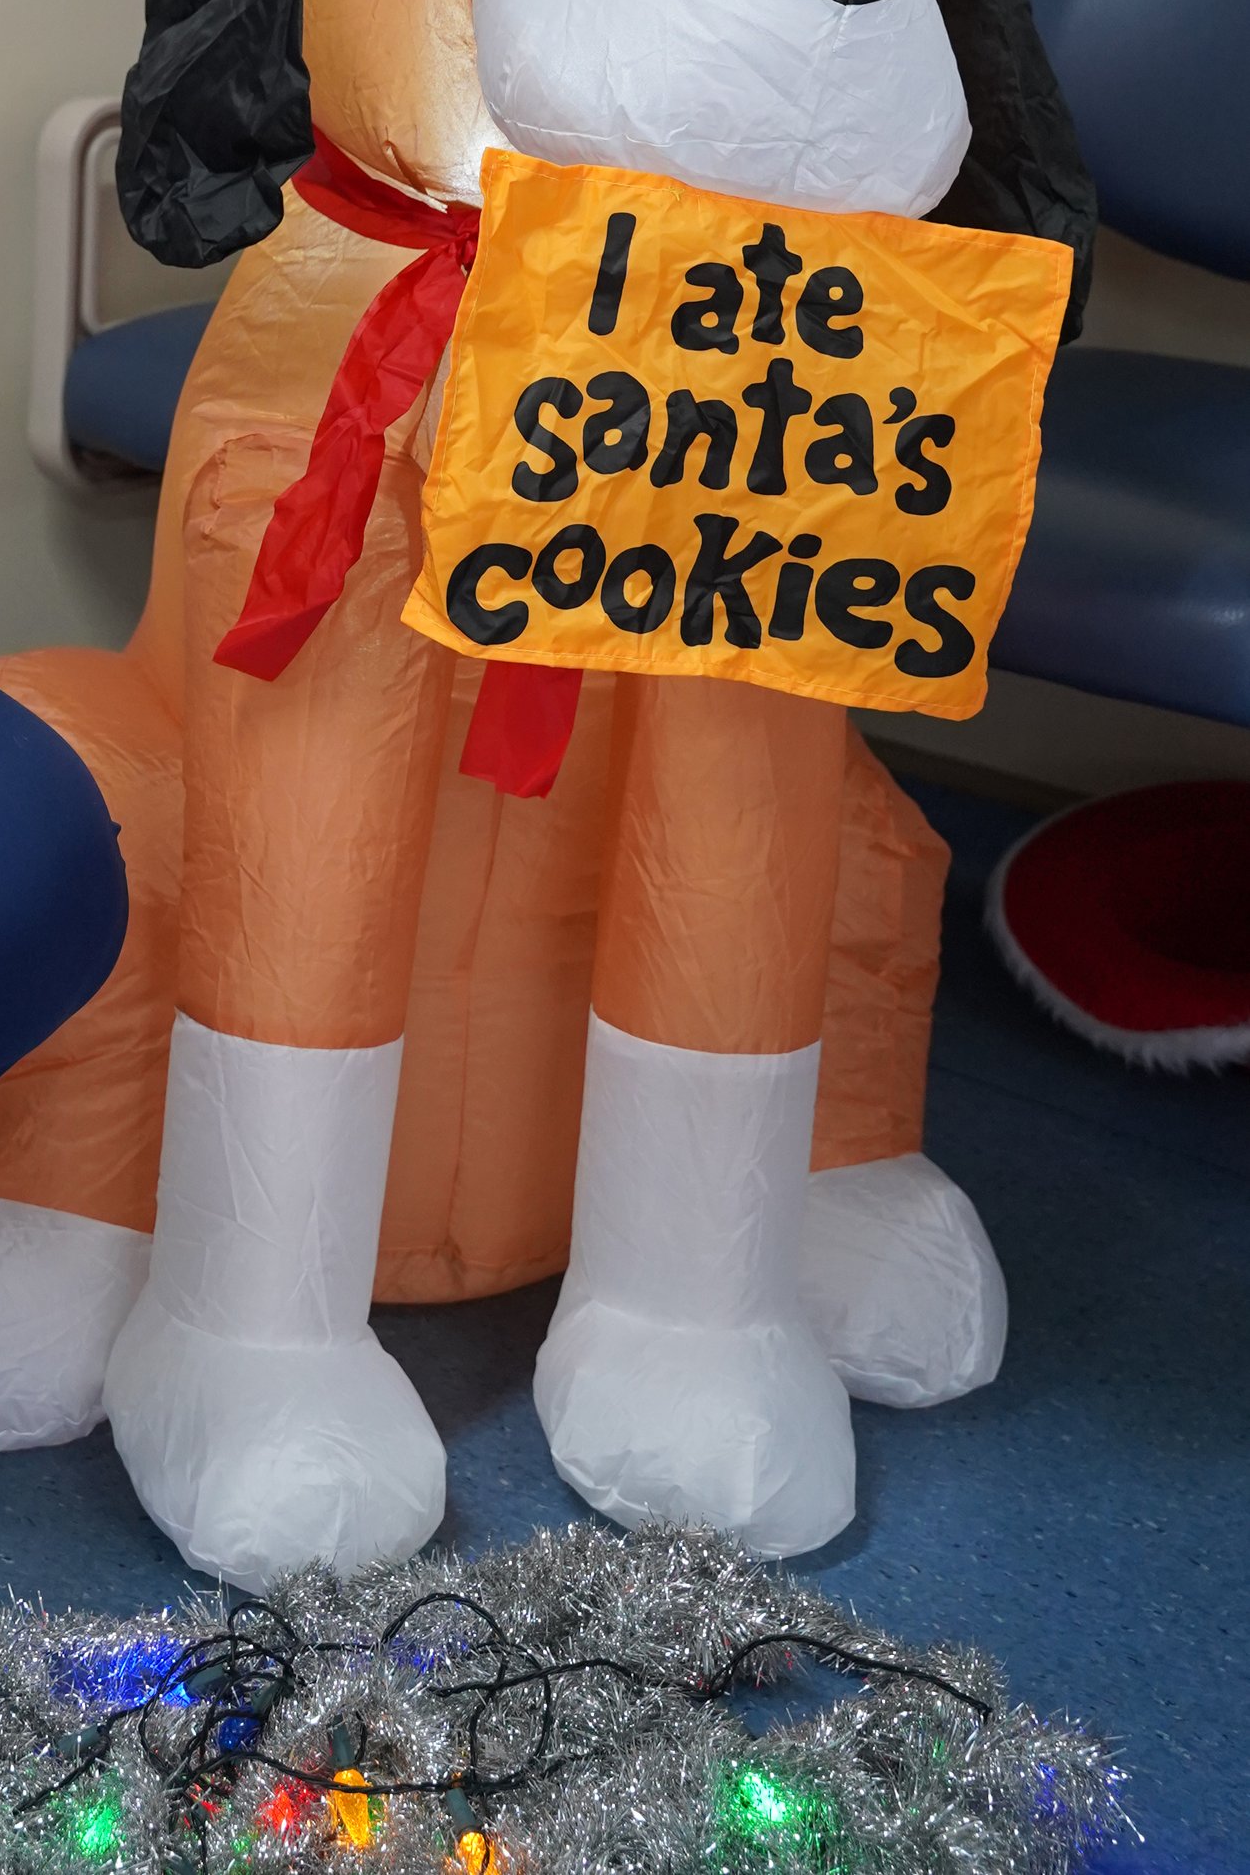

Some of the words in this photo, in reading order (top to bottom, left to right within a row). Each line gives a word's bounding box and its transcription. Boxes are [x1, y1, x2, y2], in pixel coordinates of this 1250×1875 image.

[588, 212, 637, 336] I
[670, 222, 864, 359] ate
[511, 356, 956, 516] santa's
[446, 513, 977, 678] cookies
